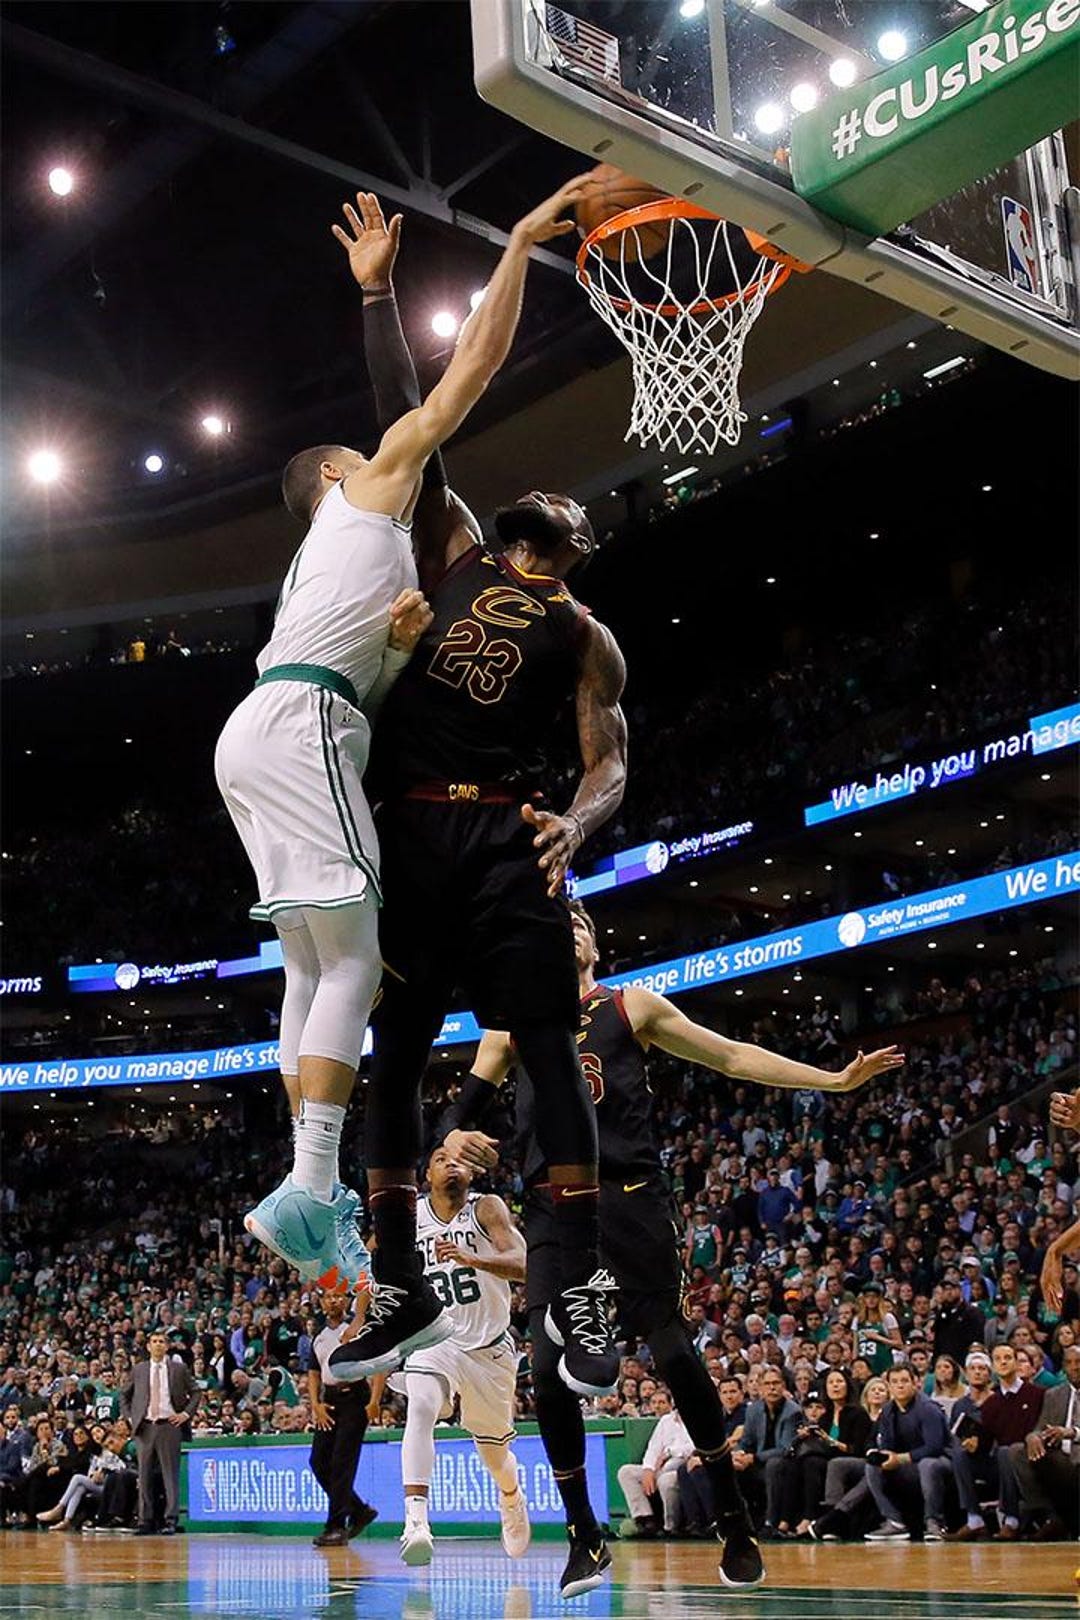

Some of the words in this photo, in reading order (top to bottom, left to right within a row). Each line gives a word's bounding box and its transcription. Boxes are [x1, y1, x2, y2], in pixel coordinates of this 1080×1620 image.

[832, 0, 1080, 160] #CUsRise
[426, 618, 523, 704] 23
[830, 782, 869, 811] We
[875, 764, 926, 797] help
[930, 749, 976, 787] you
[983, 716, 1080, 763] manage
[449, 783, 480, 801] CAVS
[1005, 868, 1047, 899] We
[867, 908, 904, 928] Safety
[906, 893, 967, 918] Insurance
[683, 952, 729, 983] life's
[733, 936, 802, 970] storms
[0, 1066, 29, 1086] We
[34, 1063, 78, 1086] help
[82, 1063, 121, 1086] you
[126, 1056, 209, 1081] manage
[213, 1048, 254, 1070] life's
[423, 1267, 482, 1308] 36
[218, 1459, 330, 1513] NBAStore.co
